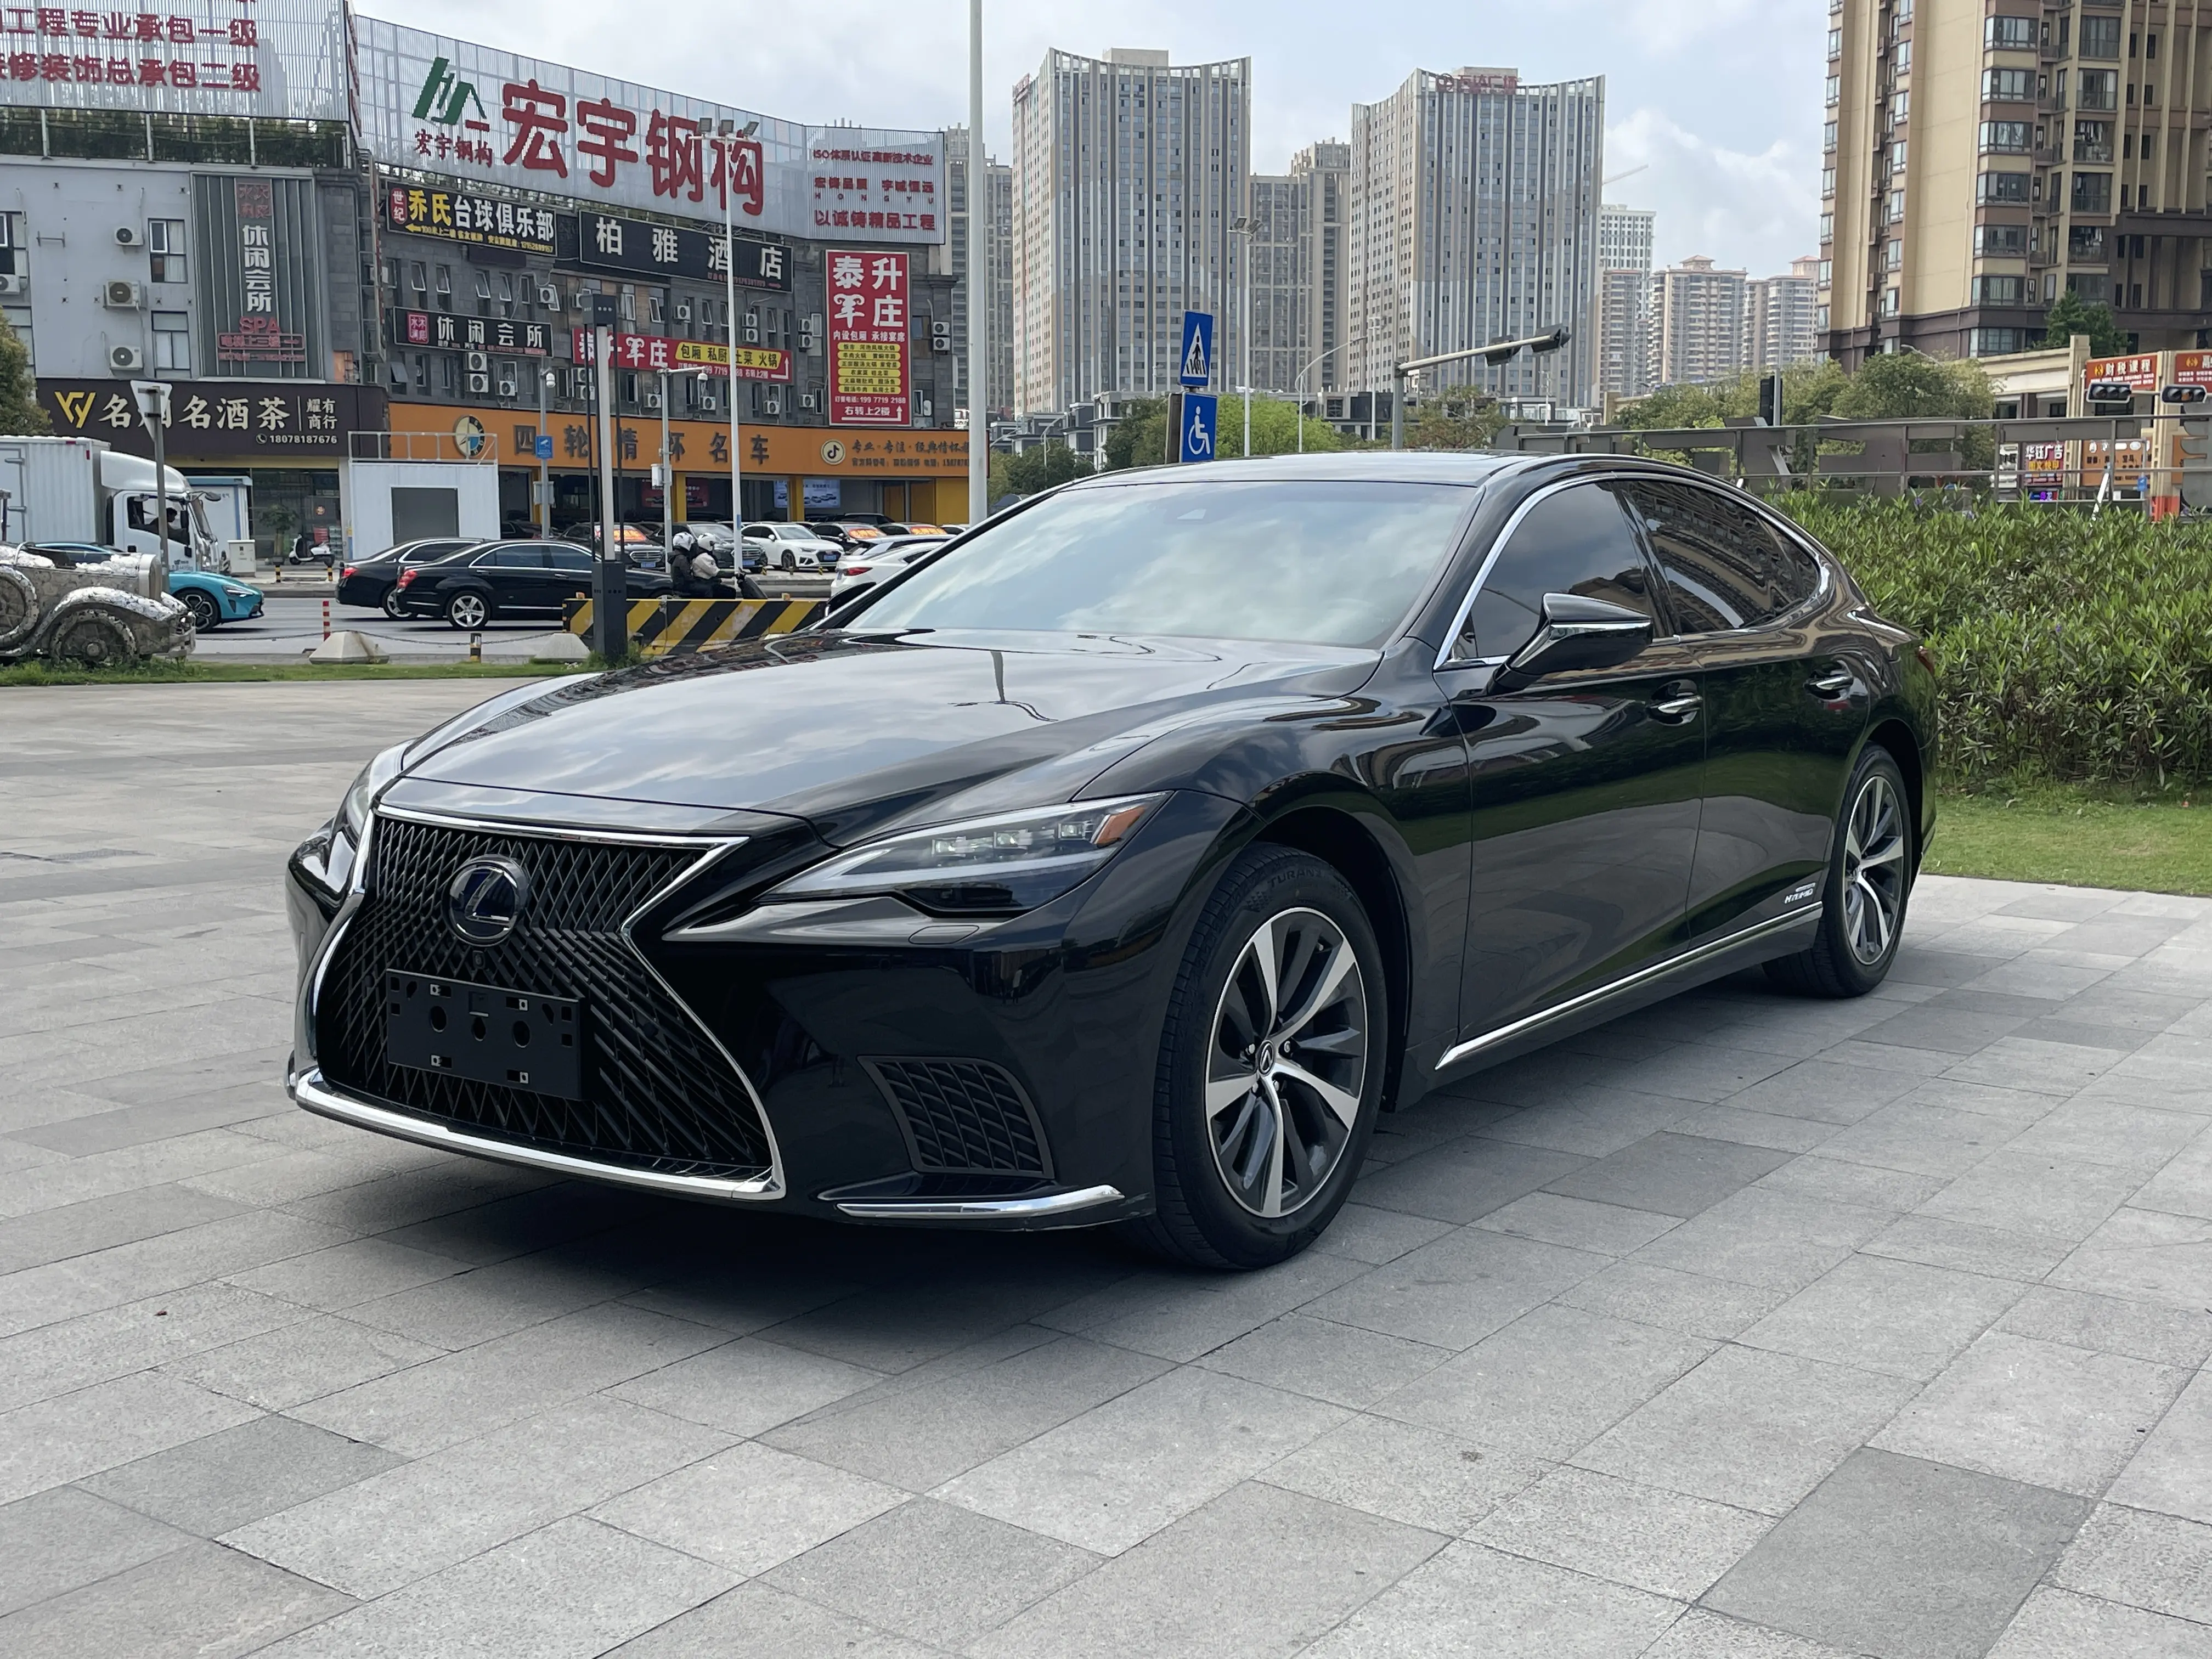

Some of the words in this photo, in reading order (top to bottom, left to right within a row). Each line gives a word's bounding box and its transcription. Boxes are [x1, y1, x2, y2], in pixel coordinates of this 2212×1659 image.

[0, 8, 258, 48] 工程专业承包一级
[414, 129, 493, 168] 宏宇钢构
[503, 79, 764, 216] 宏宇钢构
[392, 190, 405, 221] 世纪
[408, 189, 554, 241] 乔氏台球俱乐部
[814, 210, 935, 230] 以诚铸精品工程
[596, 217, 783, 280] 柏雅酒店
[242, 224, 272, 313] 休闲会所
[833, 255, 903, 291] 泰升
[239, 315, 281, 334] SPA
[833, 293, 904, 329] 羊庄
[437, 316, 543, 348] 休闲会所
[681, 343, 702, 360] 包厢
[707, 347, 727, 363] 私厨
[759, 352, 777, 368] 火锅
[714, 366, 727, 376] 7719
[306, 398, 336, 413] 耀有
[307, 414, 338, 430] 商行
[269, 434, 338, 444] 18078187676
